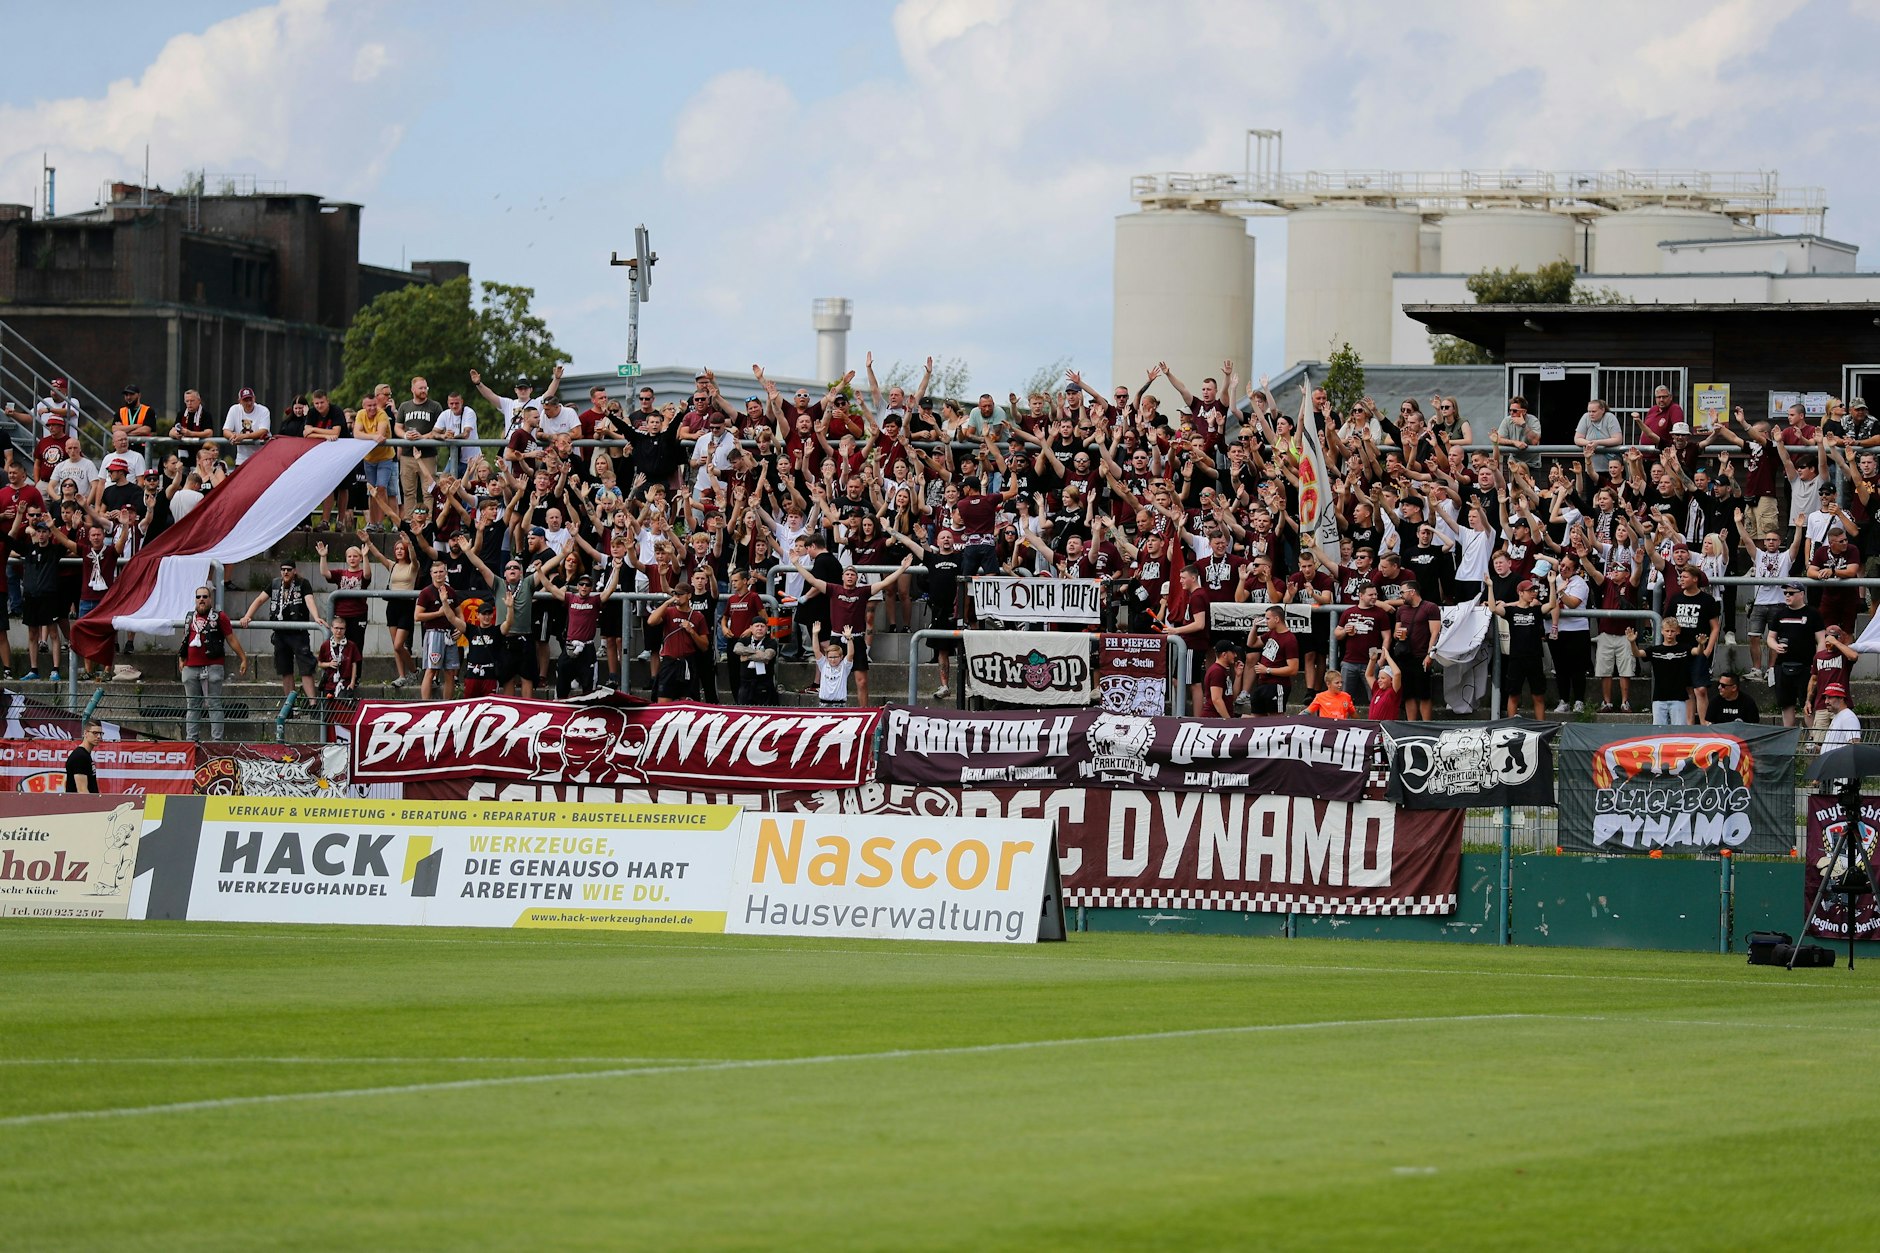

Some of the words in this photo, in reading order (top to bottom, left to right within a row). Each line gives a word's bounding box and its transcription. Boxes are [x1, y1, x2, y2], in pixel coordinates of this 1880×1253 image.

[1676, 604, 1701, 617] BFC
[1105, 637, 1118, 647] FH
[1121, 638, 1161, 649] PIEFKES
[360, 702, 553, 766] BANDA
[641, 710, 863, 770] INVICTA
[885, 709, 1078, 758] FRAKTION-H
[119, 751, 187, 764] MEISTER
[1170, 722, 1246, 765] OST
[1246, 724, 1373, 773] BERLIN
[195, 759, 234, 787] BFC
[1184, 771, 1210, 786] CLUB
[1595, 786, 1751, 814] BLACKBOYS
[228, 806, 285, 817] VERKAUF
[289, 807, 298, 817] &
[304, 808, 385, 819] VERMIETUNG
[401, 810, 467, 820] BERATUNG
[483, 811, 556, 822] REPARATUR
[571, 813, 707, 825] BAUSTELLENSERVICE
[1107, 791, 1396, 888] DYNAMO
[1592, 811, 1752, 848] DYNAMO
[219, 831, 396, 877] HACK
[469, 836, 615, 857] WERKZEUGE,
[752, 819, 1035, 891] Nascor
[464, 859, 501, 876] DIE
[509, 860, 620, 879] GENAUSO
[627, 861, 690, 880] HART
[26, 886, 59, 896] Küche
[218, 880, 388, 897] WERKZEUGHANDEL
[460, 881, 574, 901] ARBEITEN
[582, 884, 625, 901] WIE
[632, 884, 671, 903] DU.
[12, 907, 30, 916] Tel.
[33, 908, 52, 917] 030
[54, 908, 74, 917] 925
[531, 912, 694, 926] www.hack-werkzeughandel.de
[745, 894, 1025, 941] Hausverwaltung
